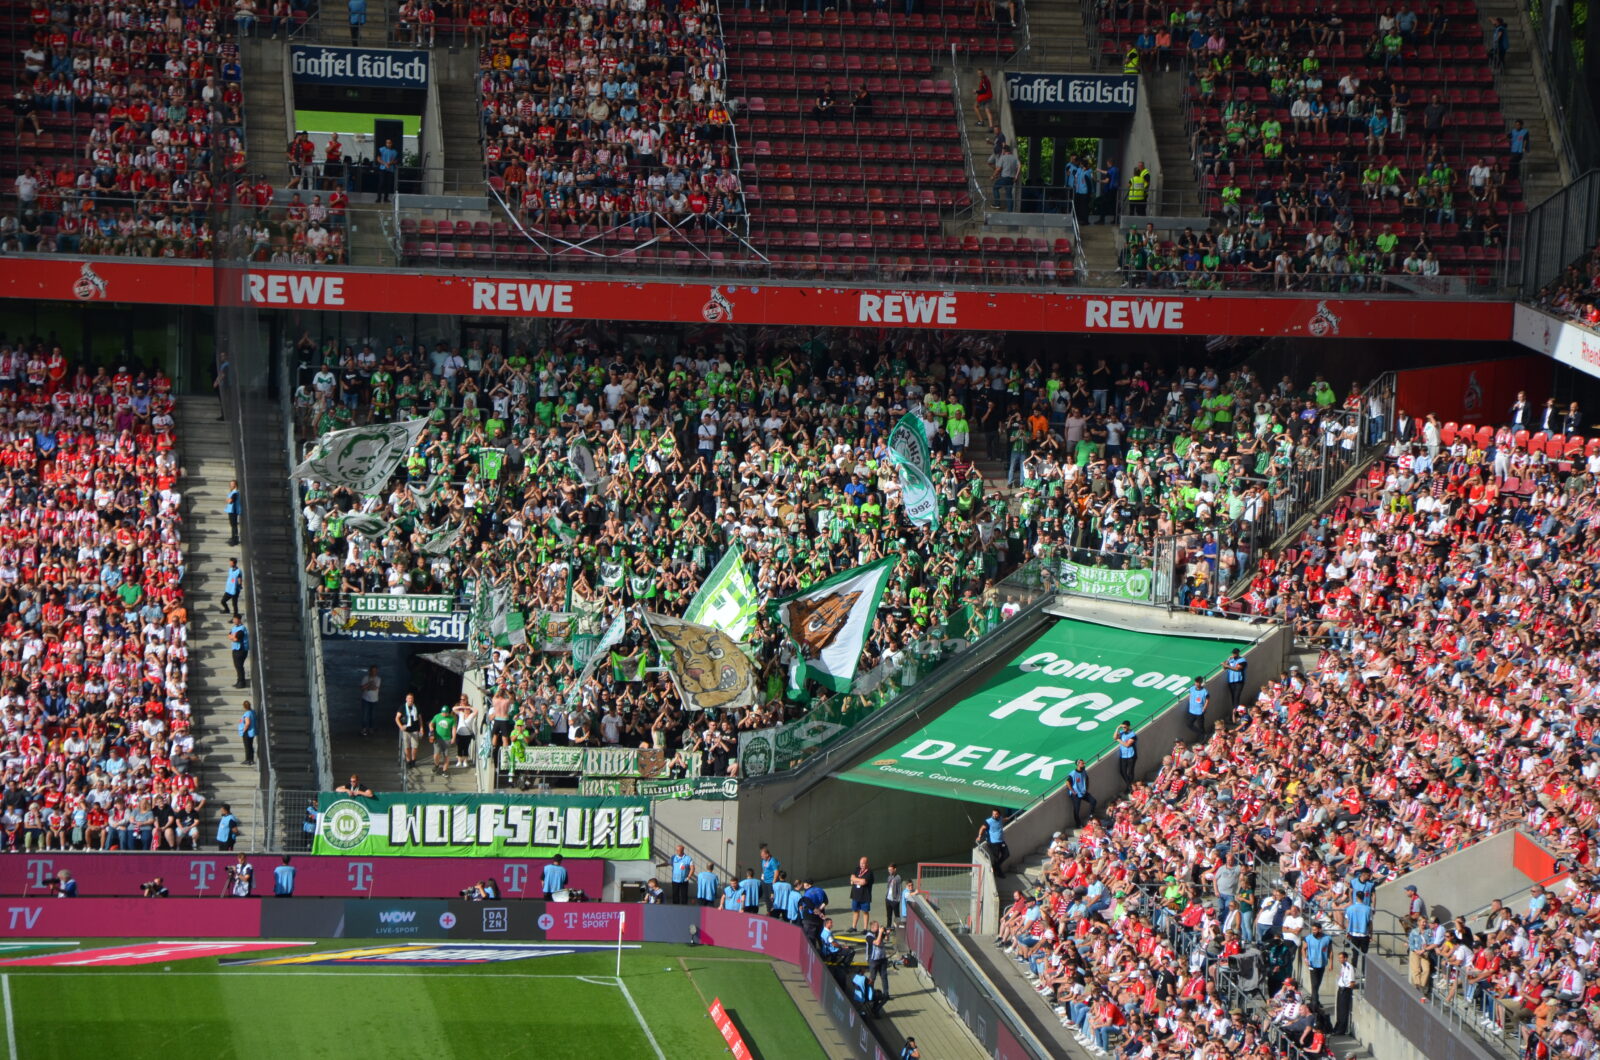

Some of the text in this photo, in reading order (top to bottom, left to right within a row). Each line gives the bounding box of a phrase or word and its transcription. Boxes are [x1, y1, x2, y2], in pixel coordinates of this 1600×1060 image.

[292, 51, 426, 83] Gaffel Kölsch
[1007, 77, 1135, 107] Gaffel Kölsch
[242, 274, 344, 305] REWE
[473, 282, 573, 312] REWE
[859, 294, 957, 324] REWE
[1085, 299, 1183, 329] REWE
[1019, 652, 1134, 684] Come
[989, 686, 1144, 731] FC!
[901, 739, 1075, 780] DEVK
[643, 783, 690, 795] SALZGITTER
[879, 765, 1031, 795] Gesagt. Getan. Geholfen.
[389, 804, 646, 849] WOLFSBURG
[8, 907, 43, 929] TV
[379, 911, 416, 923] WOW
[582, 920, 609, 928] SPORT
